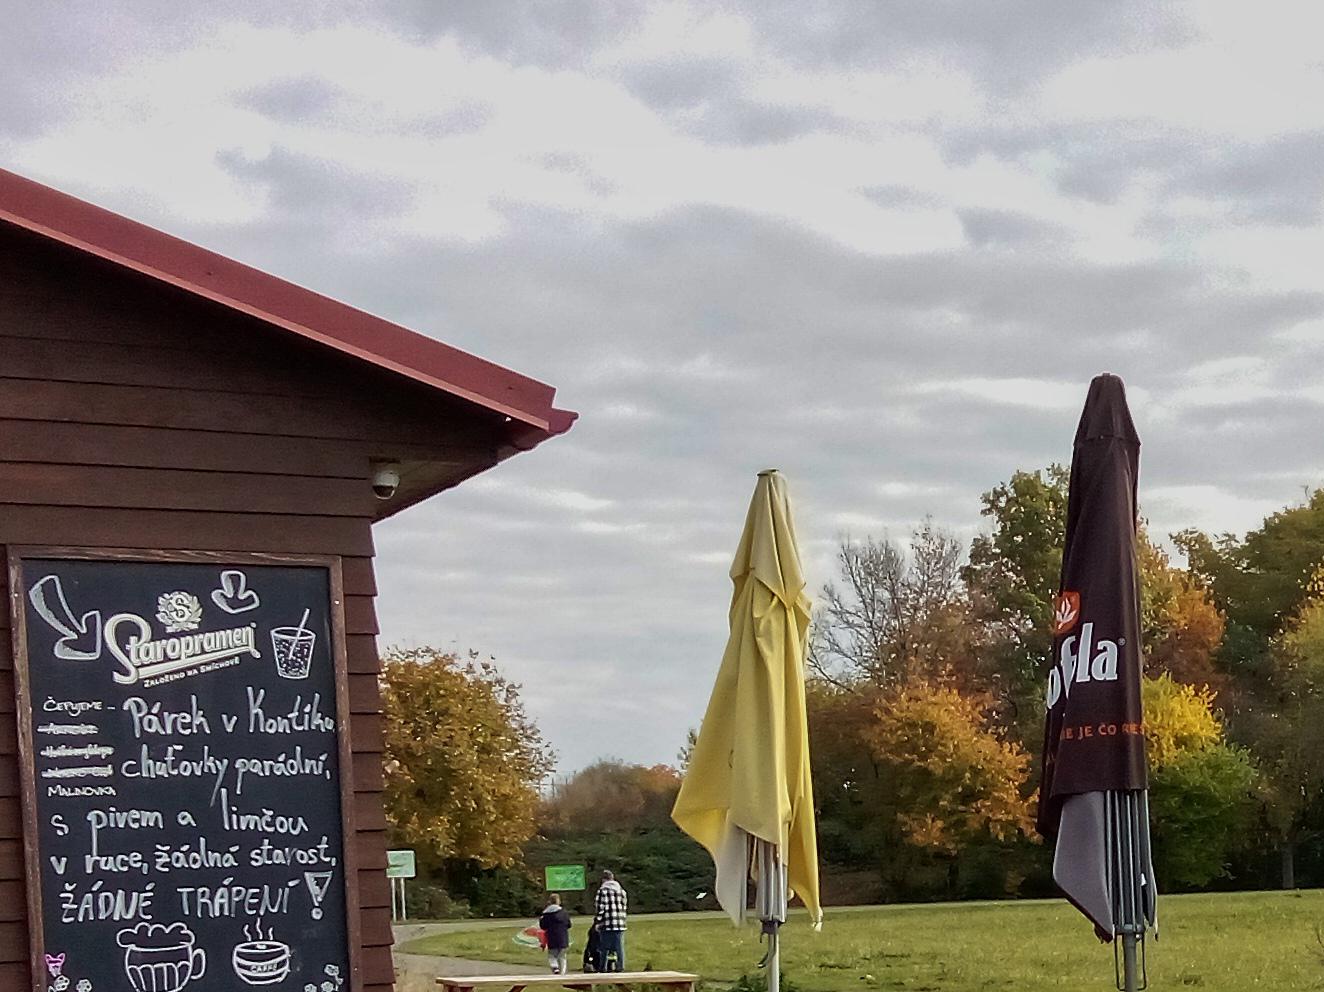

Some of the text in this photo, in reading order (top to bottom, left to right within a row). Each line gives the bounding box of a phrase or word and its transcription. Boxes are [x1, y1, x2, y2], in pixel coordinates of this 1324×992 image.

[104, 613, 261, 685] Staropramen
[122, 694, 211, 738] Párek
[221, 713, 238, 733] v
[234, 745, 331, 795] parádní,
[50, 787, 309, 857] s pivem a limčou
[50, 835, 337, 875] v ruce, žádná starost,
[58, 880, 156, 923] ŽÁDNÉ
